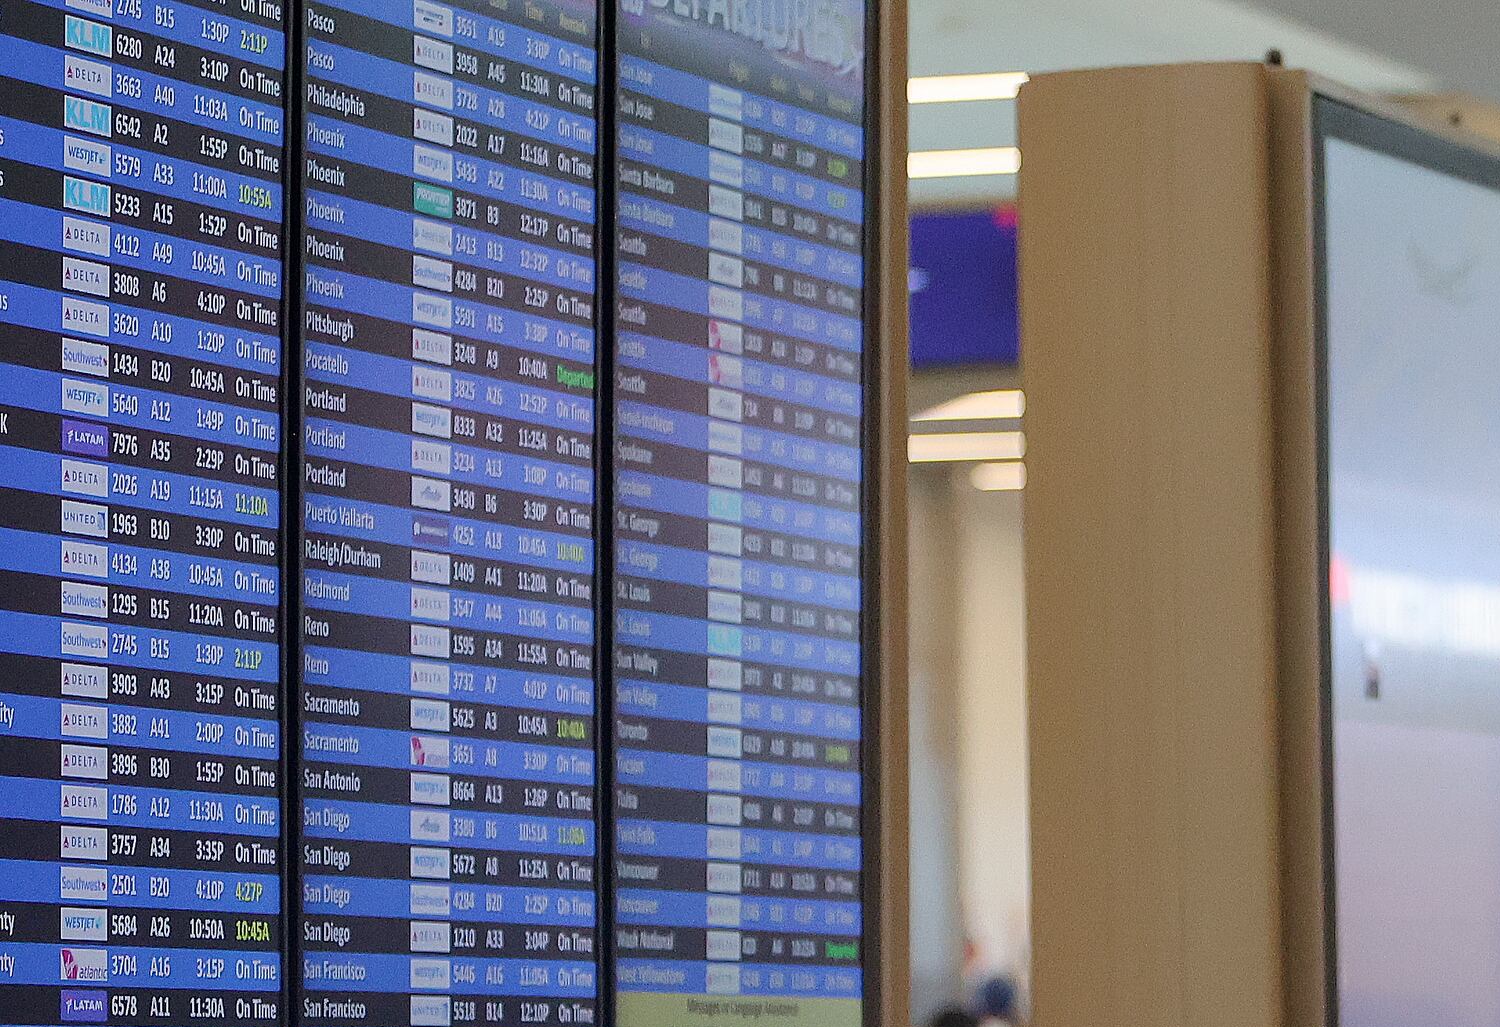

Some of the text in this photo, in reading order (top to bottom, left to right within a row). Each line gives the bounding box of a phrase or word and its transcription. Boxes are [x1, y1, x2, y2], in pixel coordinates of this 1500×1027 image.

[307, 8, 335, 34] Pasco
[67, 17, 280, 97] KLM 6280 A24 3:10P On Time
[307, 46, 334, 71] Pasco
[307, 83, 365, 117] Philadelphia
[307, 122, 345, 149] Phoenix
[115, 153, 141, 178] 5579
[153, 162, 174, 186] A33
[193, 171, 227, 199] 11:00A
[238, 184, 272, 210] 10:55A
[307, 159, 345, 187] Phoenix
[306, 197, 345, 224] Phoenix
[306, 234, 344, 262] Phoenix
[306, 273, 344, 299] Phoenix
[306, 311, 354, 343] Pittsburgh
[305, 348, 349, 376] Pocatello
[113, 352, 139, 377] 1434
[151, 359, 171, 383] B20
[190, 367, 225, 394] 10:45A
[235, 376, 250, 398] On
[251, 379, 276, 403] Time
[305, 387, 346, 413] Portland
[305, 423, 346, 450] Portland
[75, 431, 275, 480] LATAM 7976 A35 2:29P On Time
[305, 463, 346, 488] Portland
[305, 501, 374, 530] Puerto Vallarta
[64, 512, 275, 557] UNITED 1963 B10 3:30P On Time
[305, 539, 381, 569] Raleigh/Durham
[304, 577, 350, 601] Redmond
[112, 592, 137, 616] 1295
[150, 597, 170, 620] B15
[189, 603, 224, 627] 11:20A
[234, 608, 249, 630] On
[250, 610, 275, 634] Time
[304, 615, 329, 637] Reno
[111, 632, 137, 656] 2745
[150, 637, 170, 659] B15
[195, 643, 224, 665] 1:30P
[234, 647, 262, 670] 2:11P
[304, 654, 329, 675] Reno
[72, 673, 275, 711] DELTA 3903 A43 3:15P On Time
[304, 692, 360, 717] Sacramento
[304, 730, 359, 754] Sacramento
[72, 753, 276, 788] DELTA 3896 B30 1:55P On Time
[304, 768, 361, 792] San Antonio
[303, 806, 350, 833] San Diego
[71, 833, 276, 865] DELTA 3757 A34 3:35P On Time
[304, 844, 350, 871] San Diego
[303, 884, 350, 909] San Diego
[111, 914, 138, 936] 5684
[149, 916, 171, 938] A26
[189, 918, 225, 940] 10:50A
[235, 920, 270, 942] 10:45A
[304, 920, 350, 947] San Diego
[304, 959, 366, 981] San Francisco
[74, 995, 277, 1019] LATAM 6578 A11 11:30A On Time
[303, 997, 366, 1019] San Francisco
